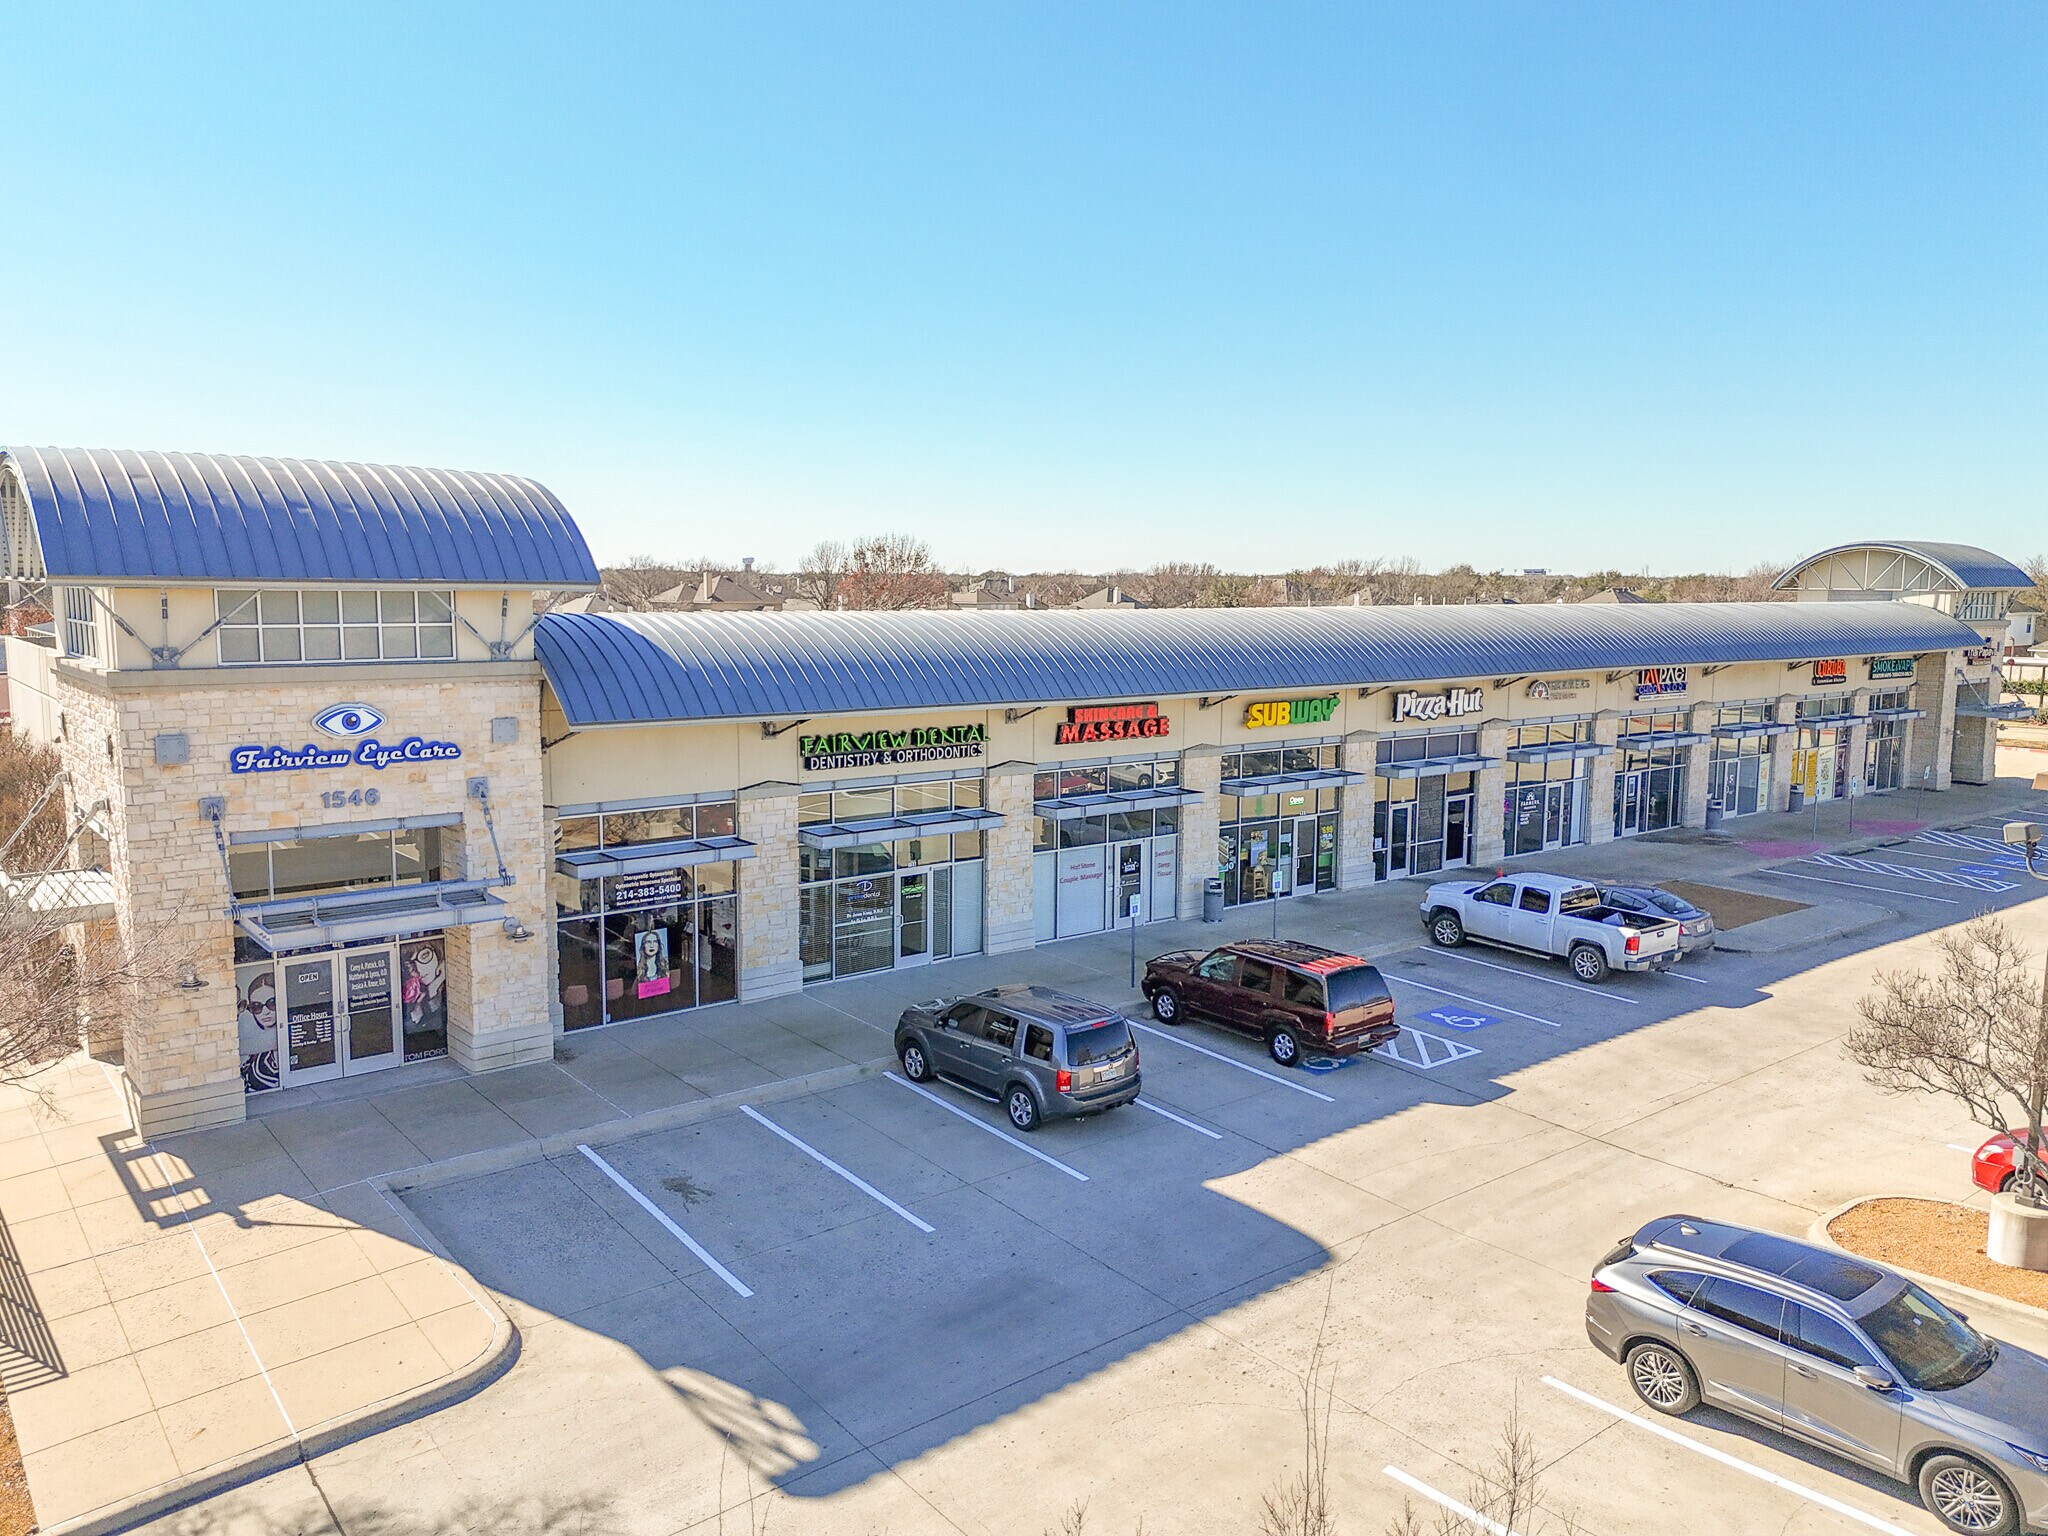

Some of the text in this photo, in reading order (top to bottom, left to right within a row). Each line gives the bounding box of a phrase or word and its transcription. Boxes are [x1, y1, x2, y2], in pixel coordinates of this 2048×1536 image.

[1549, 679, 1590, 690] FARMERS
[1075, 704, 1143, 723] SKINCARE
[1246, 697, 1341, 729] SUBWAY
[1394, 688, 1483, 722] Pizza Hut
[803, 726, 991, 754] FAIRVIEW DENTAL
[1061, 718, 1170, 744] MASSAGE
[236, 741, 461, 770] Fairview EyeCare
[810, 745, 984, 771] DENTISTRY & ORTHODONTICS
[321, 788, 381, 809] 1546
[616, 884, 681, 900] 214-383-5400
[300, 974, 318, 982] OPEN
[292, 1011, 329, 1023] Office Hours
[404, 1047, 447, 1062] TOM FORD
